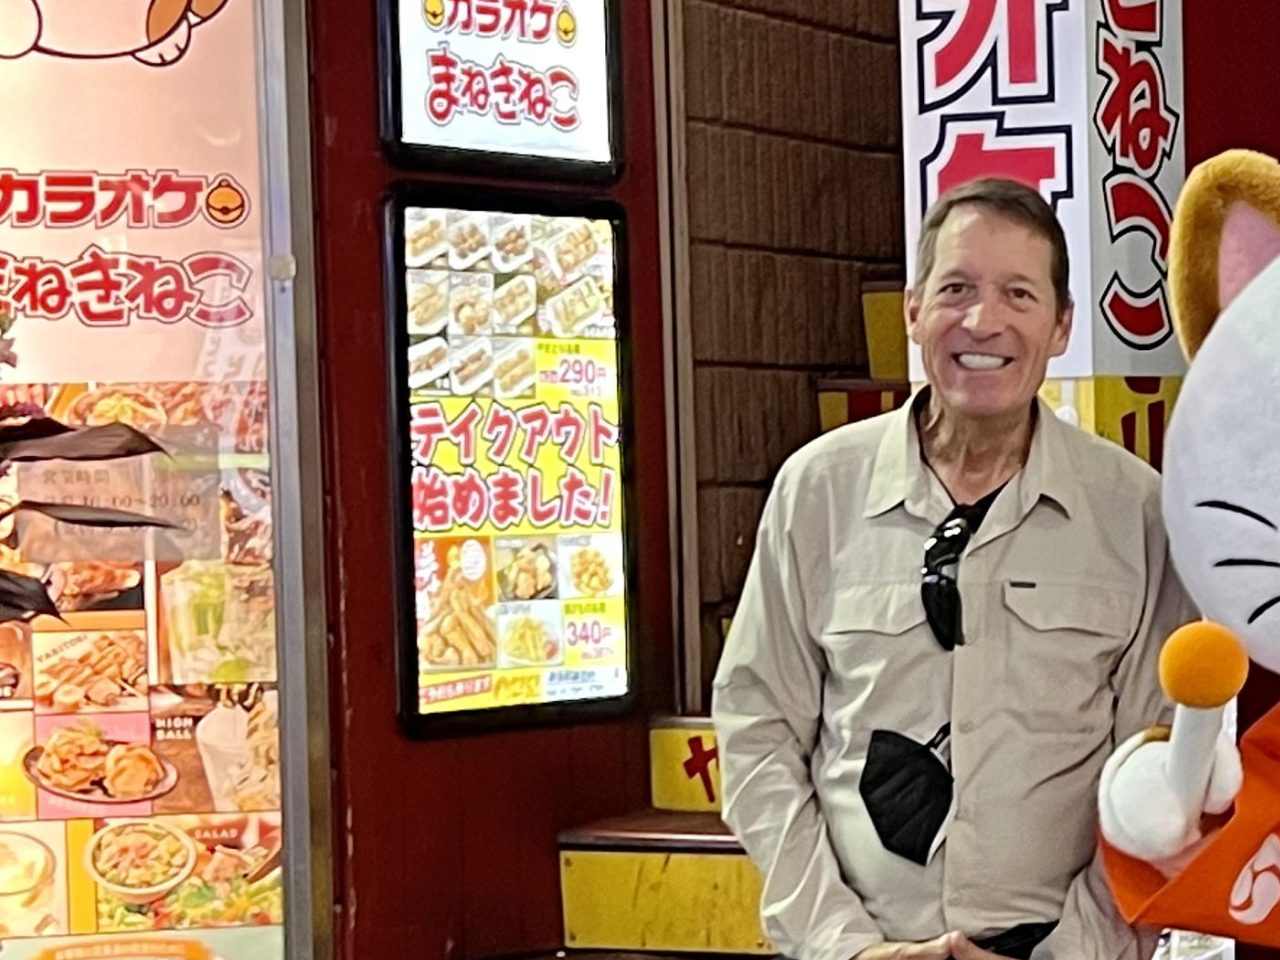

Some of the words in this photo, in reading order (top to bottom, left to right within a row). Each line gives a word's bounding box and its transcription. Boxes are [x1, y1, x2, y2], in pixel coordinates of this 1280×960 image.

[446, 0, 556, 41] カラオケ
[427, 50, 578, 129] まねきねこ
[0, 172, 205, 227] カラオケ
[0, 249, 251, 326] ねきねこ
[411, 404, 616, 463] テイクアウト
[412, 468, 615, 529] 始めました!
